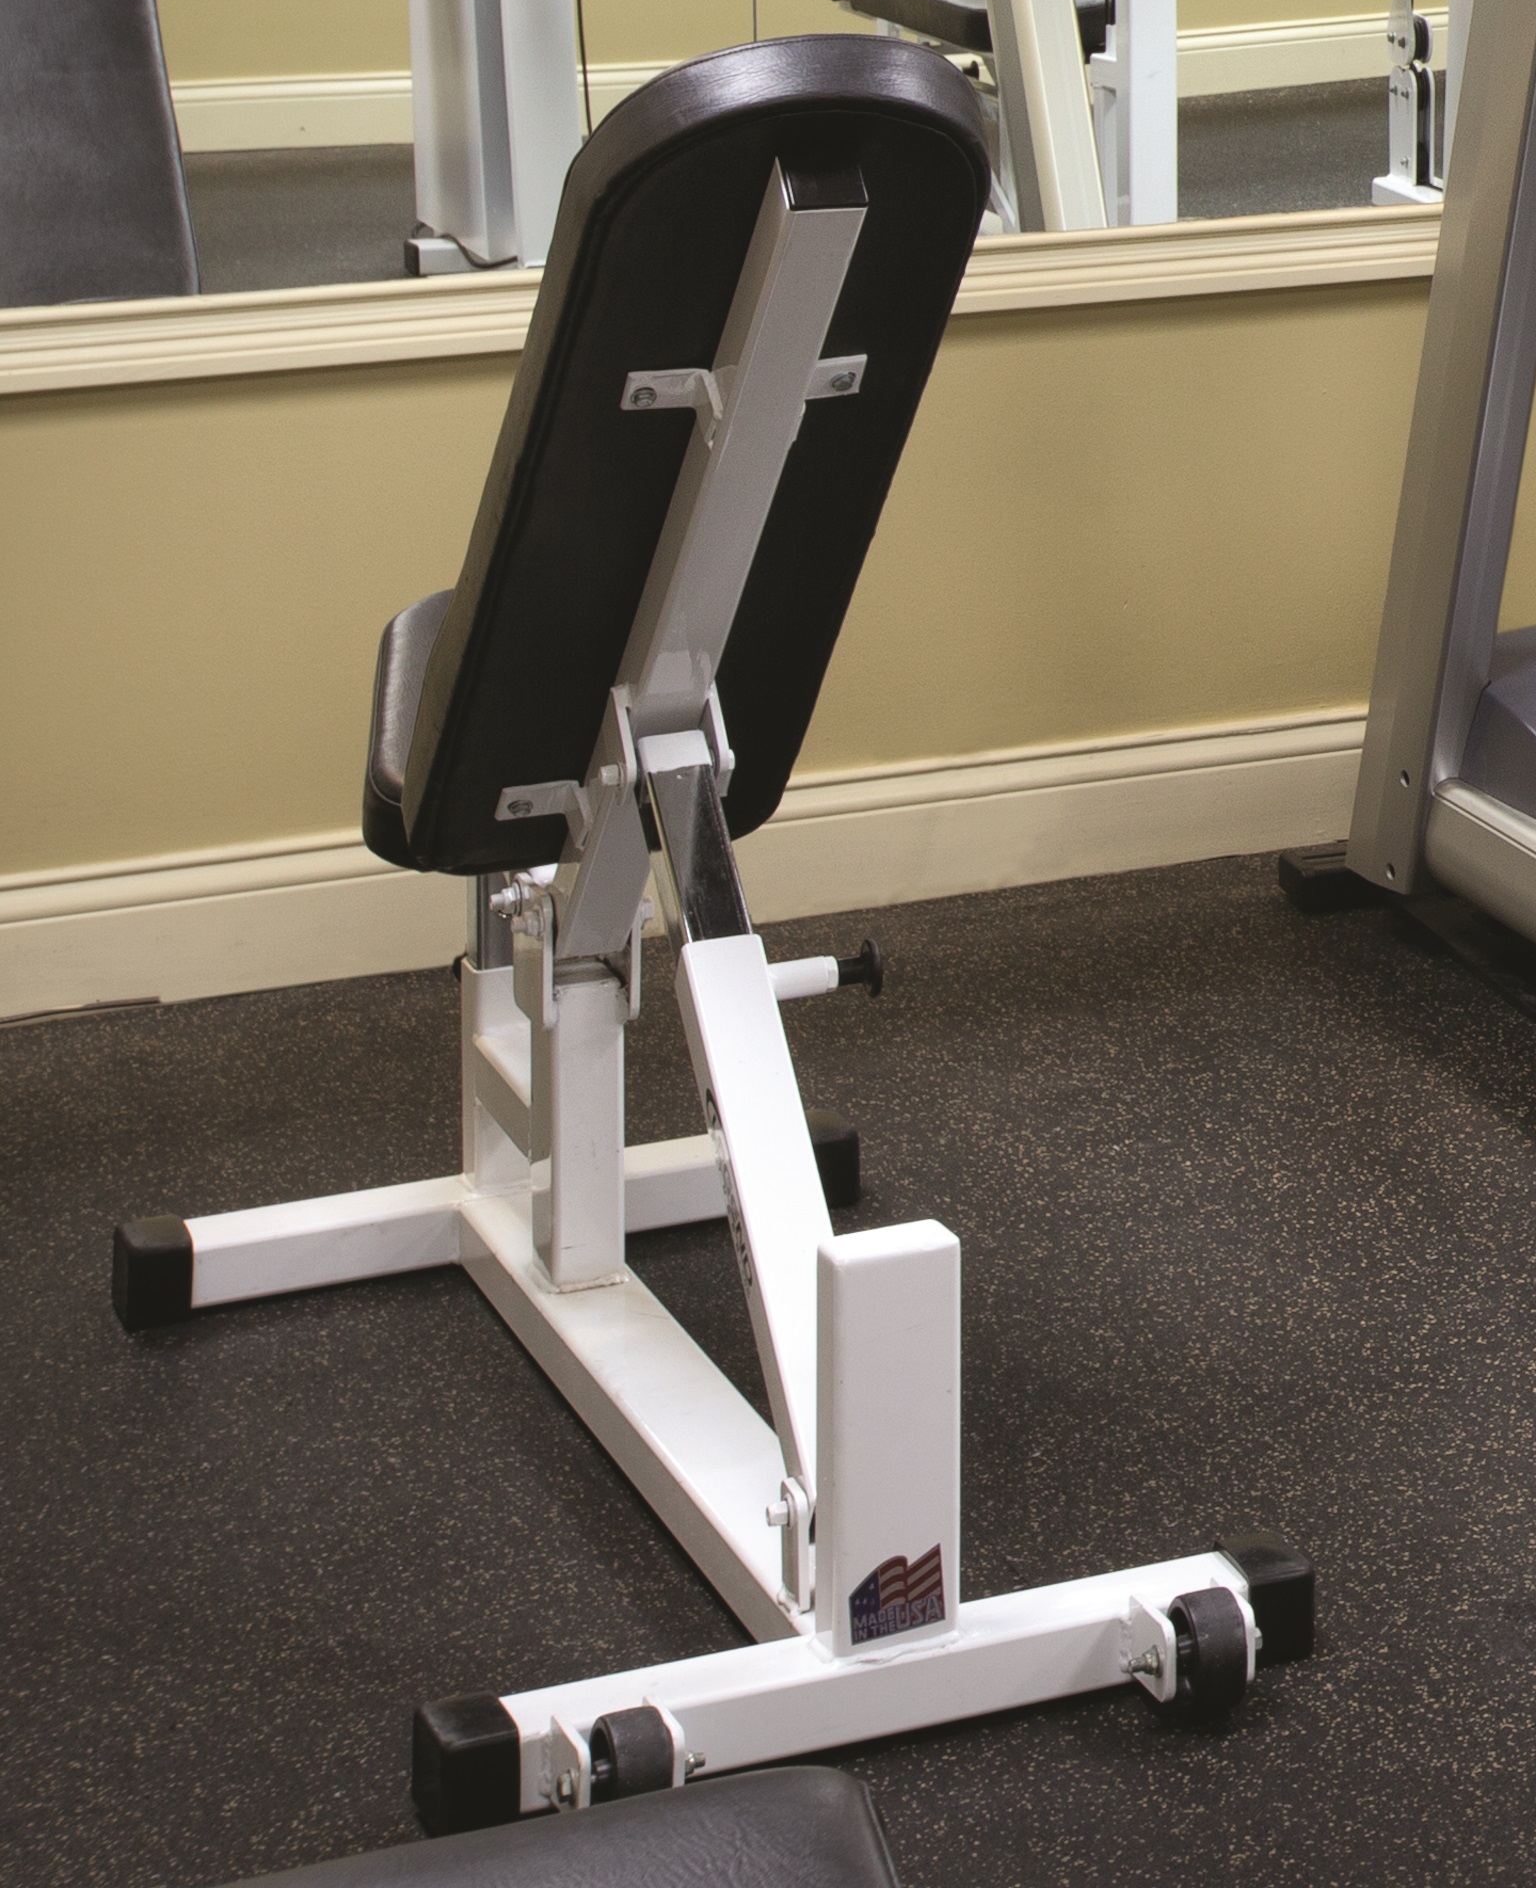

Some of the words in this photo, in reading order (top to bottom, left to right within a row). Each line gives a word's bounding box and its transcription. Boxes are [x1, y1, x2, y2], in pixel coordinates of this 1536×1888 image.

[854, 1606, 895, 1629] MADE
[896, 1596, 942, 1629] USA
[854, 1628, 867, 1640] IN
[871, 1620, 895, 1635] THE
